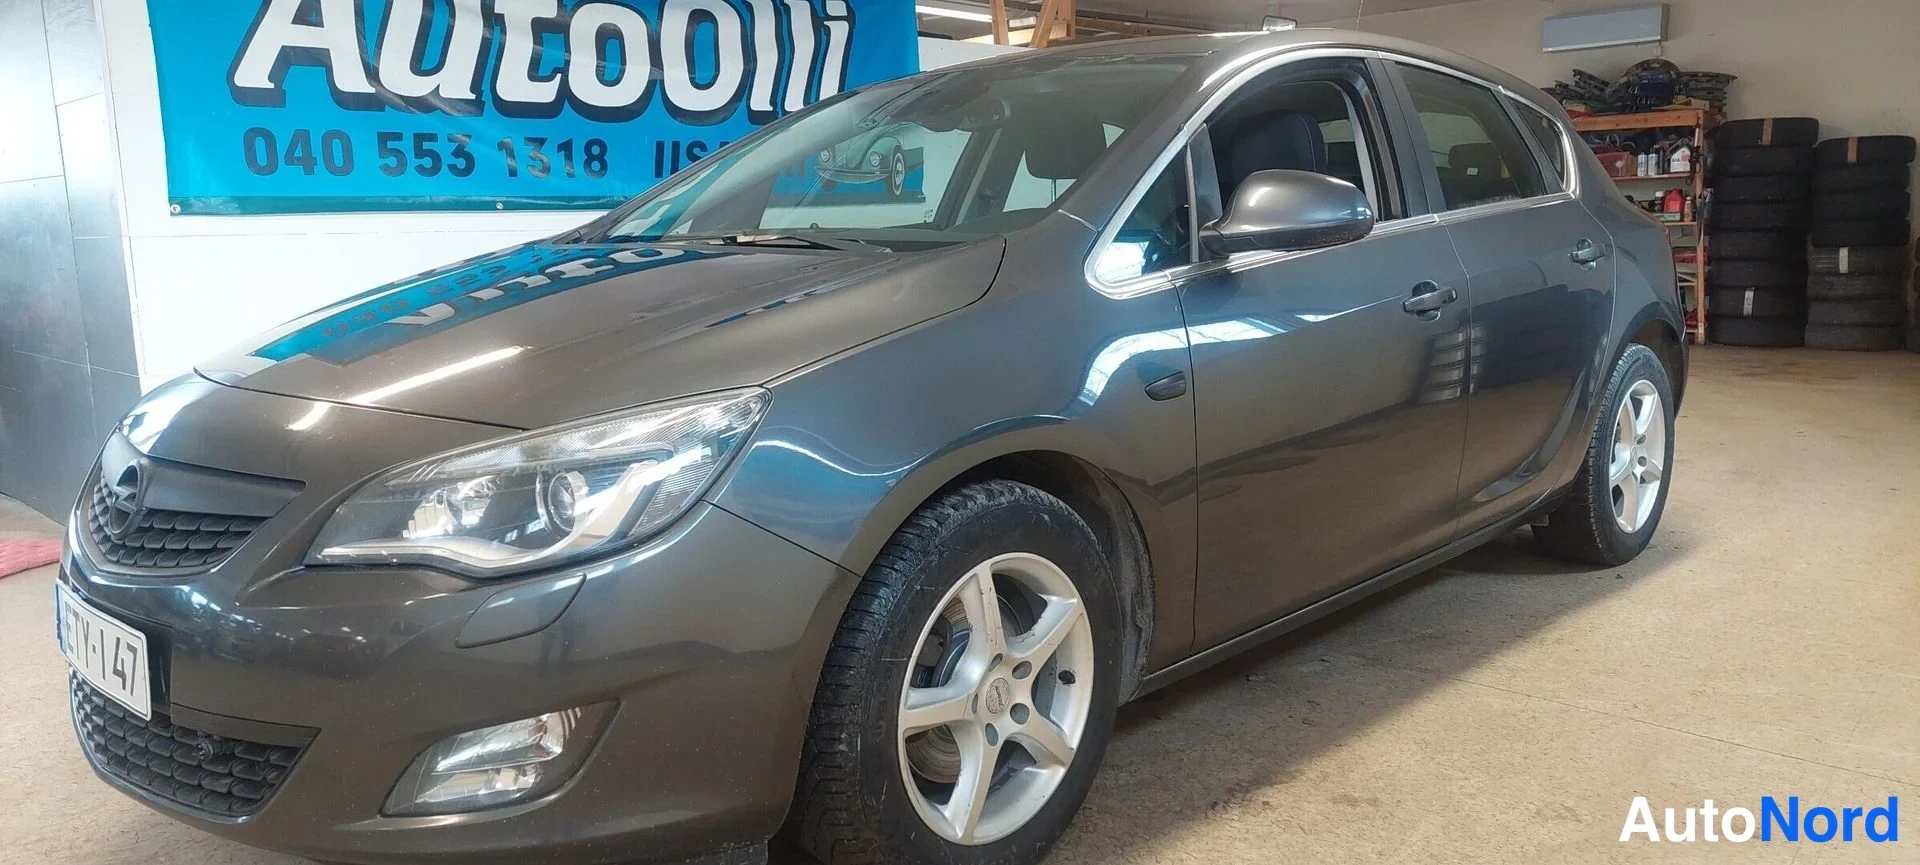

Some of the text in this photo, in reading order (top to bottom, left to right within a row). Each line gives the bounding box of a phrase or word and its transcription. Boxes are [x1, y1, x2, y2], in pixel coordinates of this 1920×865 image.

[230, 0, 855, 122] AutoOlli
[243, 127, 355, 176] 040
[377, 131, 475, 177] 553
[496, 135, 608, 179] 1318
